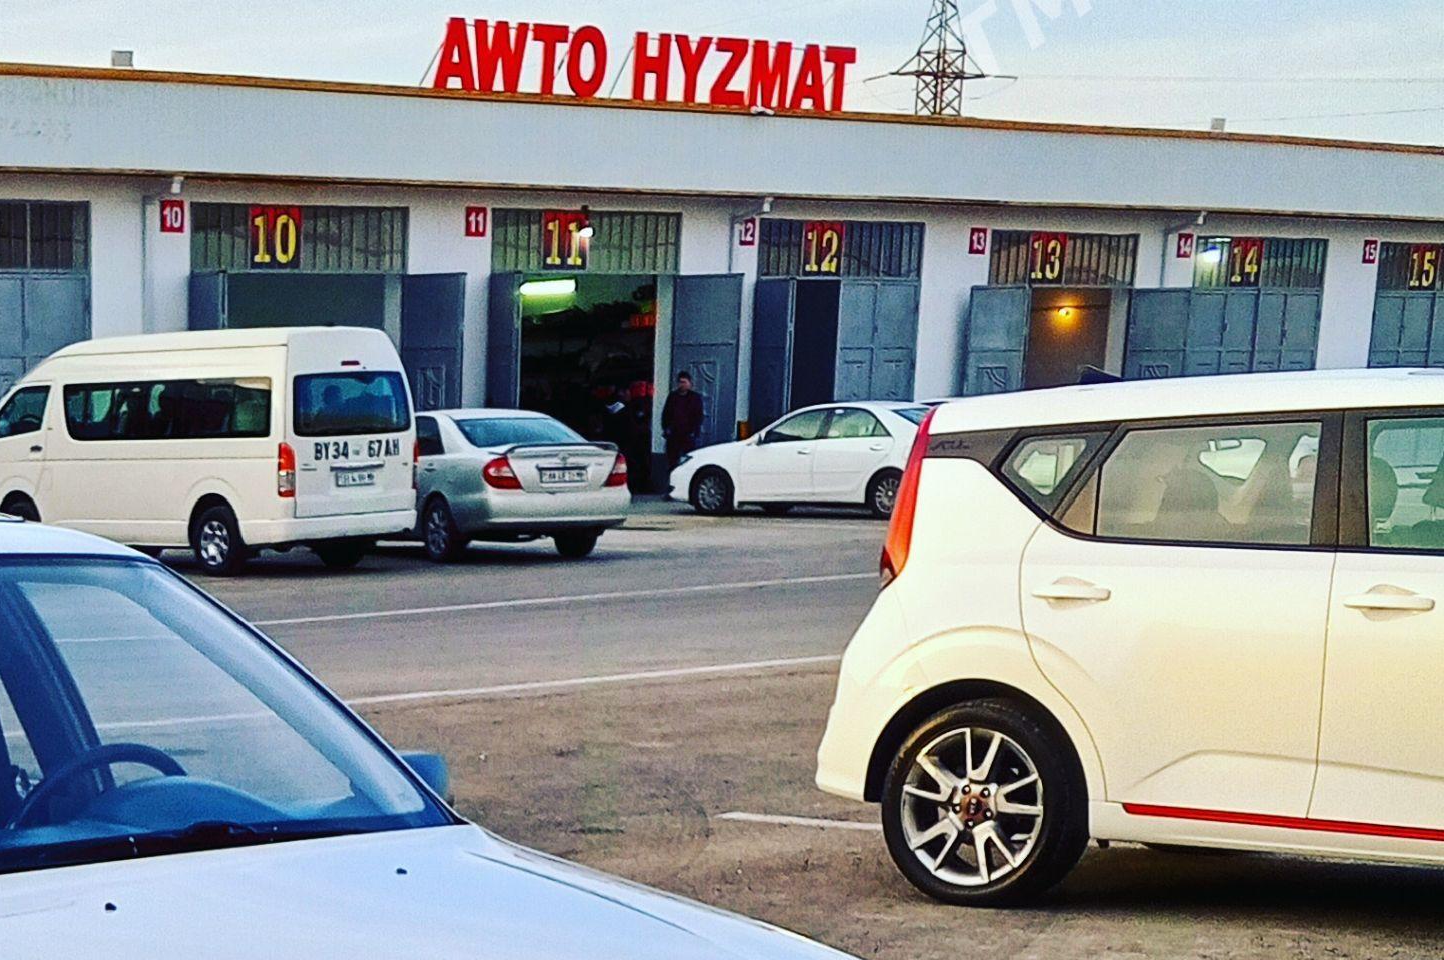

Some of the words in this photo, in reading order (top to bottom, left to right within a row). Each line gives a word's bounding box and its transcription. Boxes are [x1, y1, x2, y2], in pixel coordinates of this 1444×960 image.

[433, 17, 607, 98] AWTO
[632, 31, 856, 112] HYZMAT
[163, 206, 182, 228] 10
[468, 211, 484, 233] 11
[740, 222, 754, 242] 12
[254, 214, 296, 264] 10
[546, 219, 582, 265] 11
[805, 229, 839, 273] 12
[972, 231, 985, 250] 13
[1365, 244, 1376, 260] 15
[1031, 239, 1061, 280] 13
[1231, 246, 1258, 283] 14
[1409, 249, 1436, 287] 15
